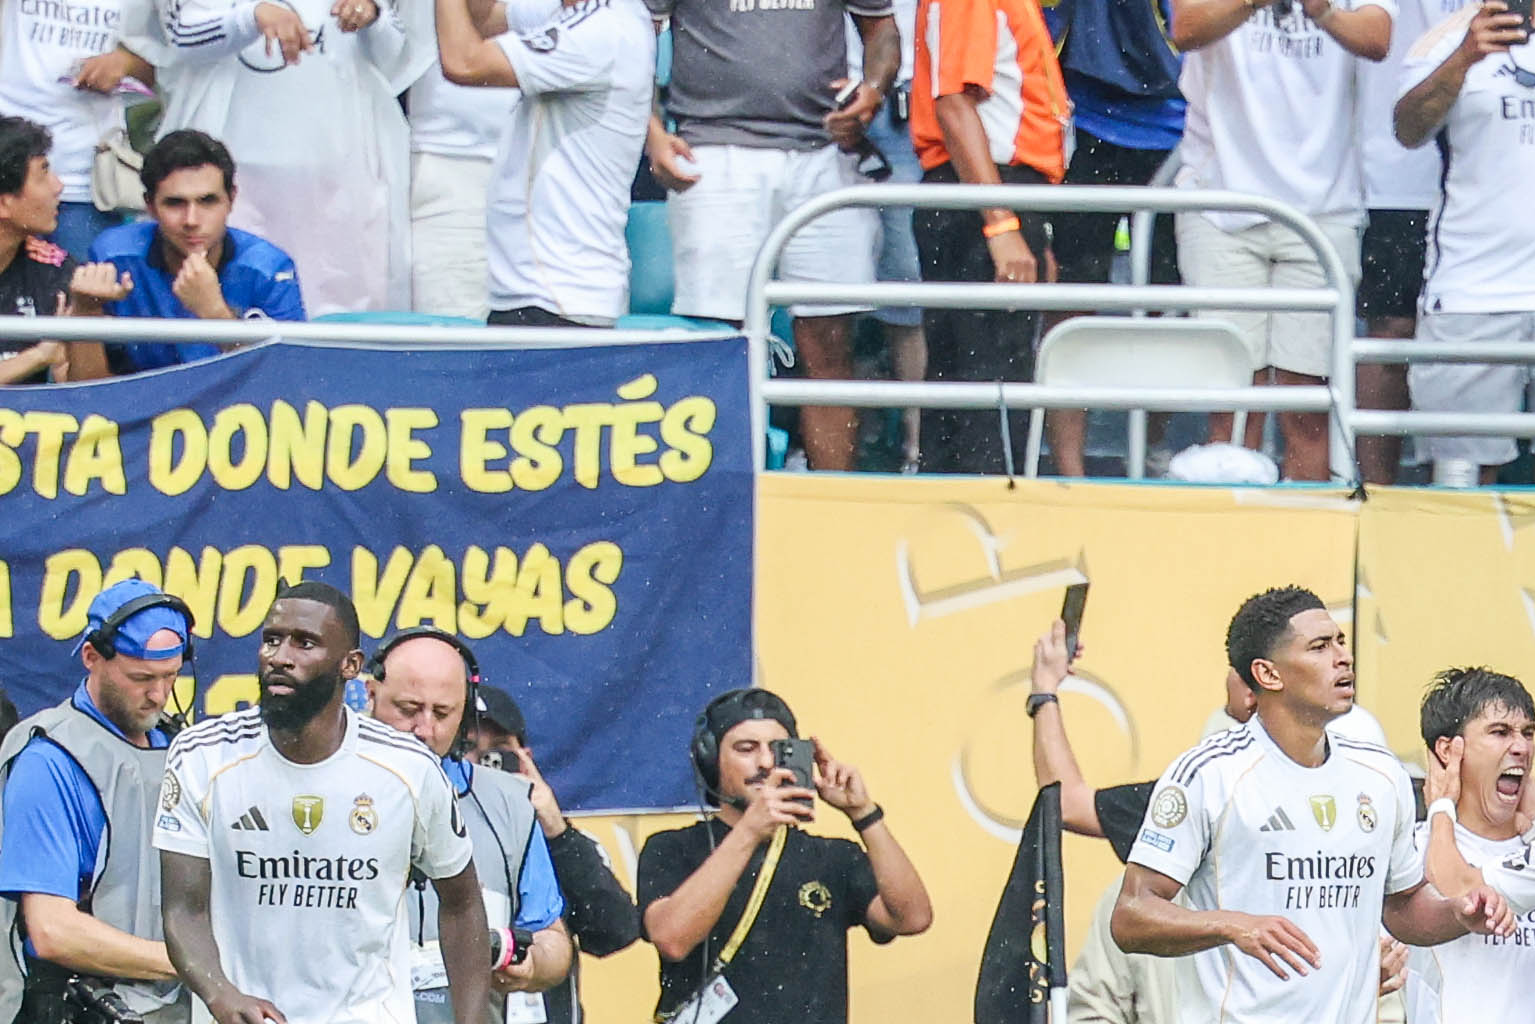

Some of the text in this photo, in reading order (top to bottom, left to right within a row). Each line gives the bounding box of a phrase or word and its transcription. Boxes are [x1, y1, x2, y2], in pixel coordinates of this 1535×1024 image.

[148, 398, 440, 496] DONDE
[459, 373, 717, 493] ESTÉS
[350, 540, 624, 641] VAYAS
[235, 849, 379, 881] Emirates
[1265, 850, 1376, 881] Emirates
[258, 884, 358, 909] FLY BETTER
[1286, 886, 1313, 909] FLY
